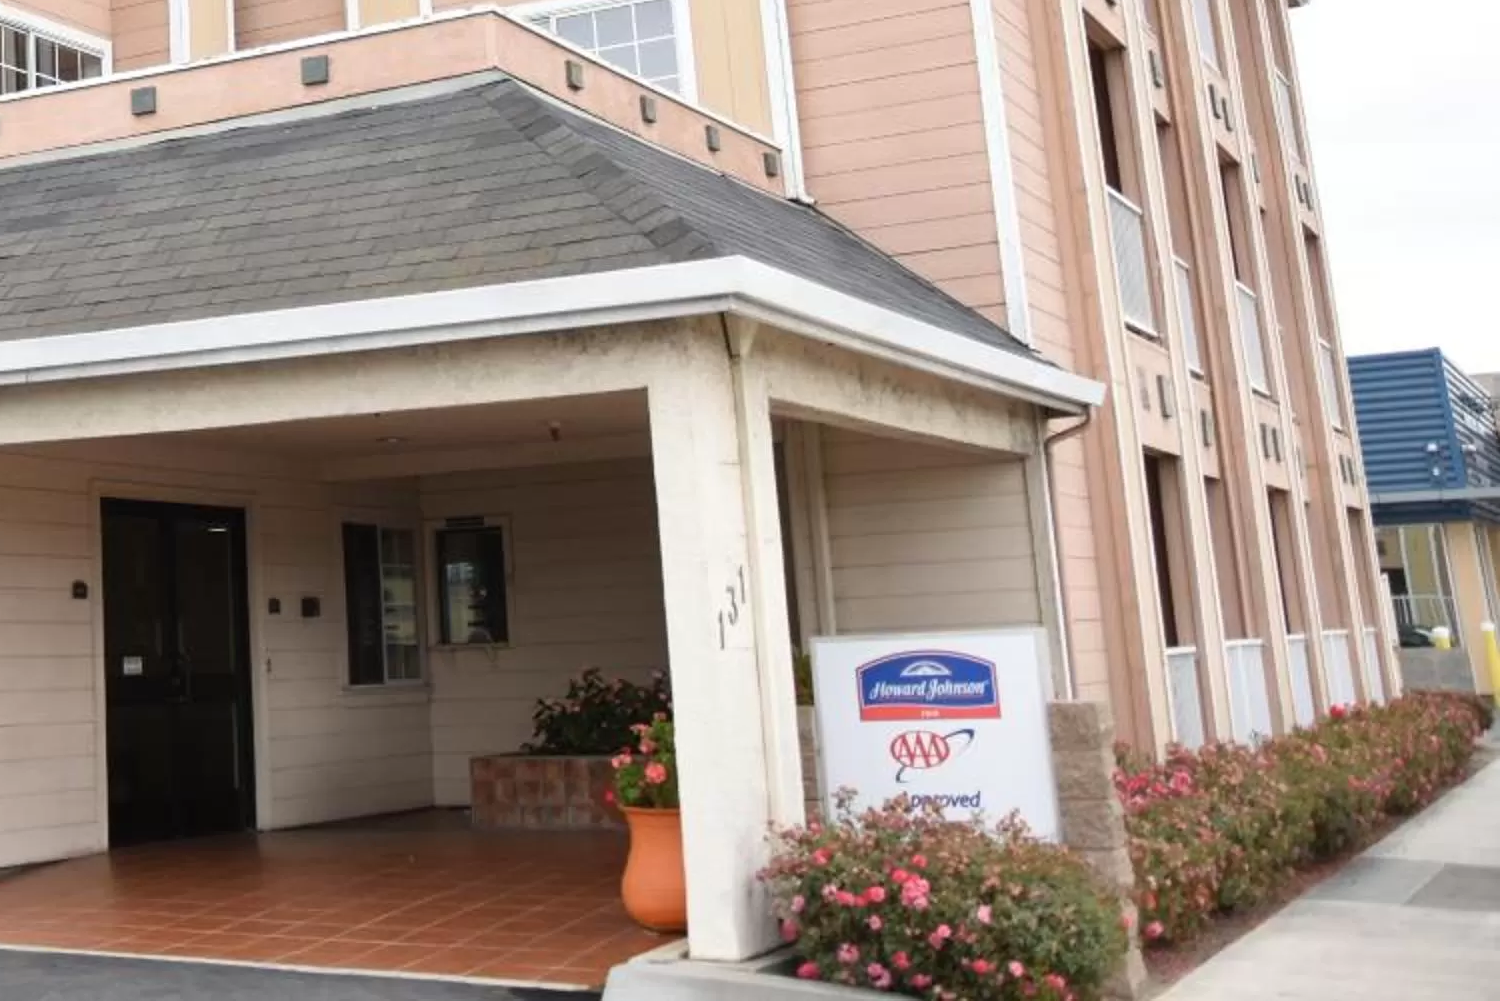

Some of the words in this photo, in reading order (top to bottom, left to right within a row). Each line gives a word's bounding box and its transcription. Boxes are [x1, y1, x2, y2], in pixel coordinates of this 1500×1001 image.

[717, 564, 746, 651] 131
[869, 681, 926, 700] Howard
[924, 679, 985, 701] Johnson
[897, 731, 946, 768] AAA
[902, 790, 982, 812] pproved
